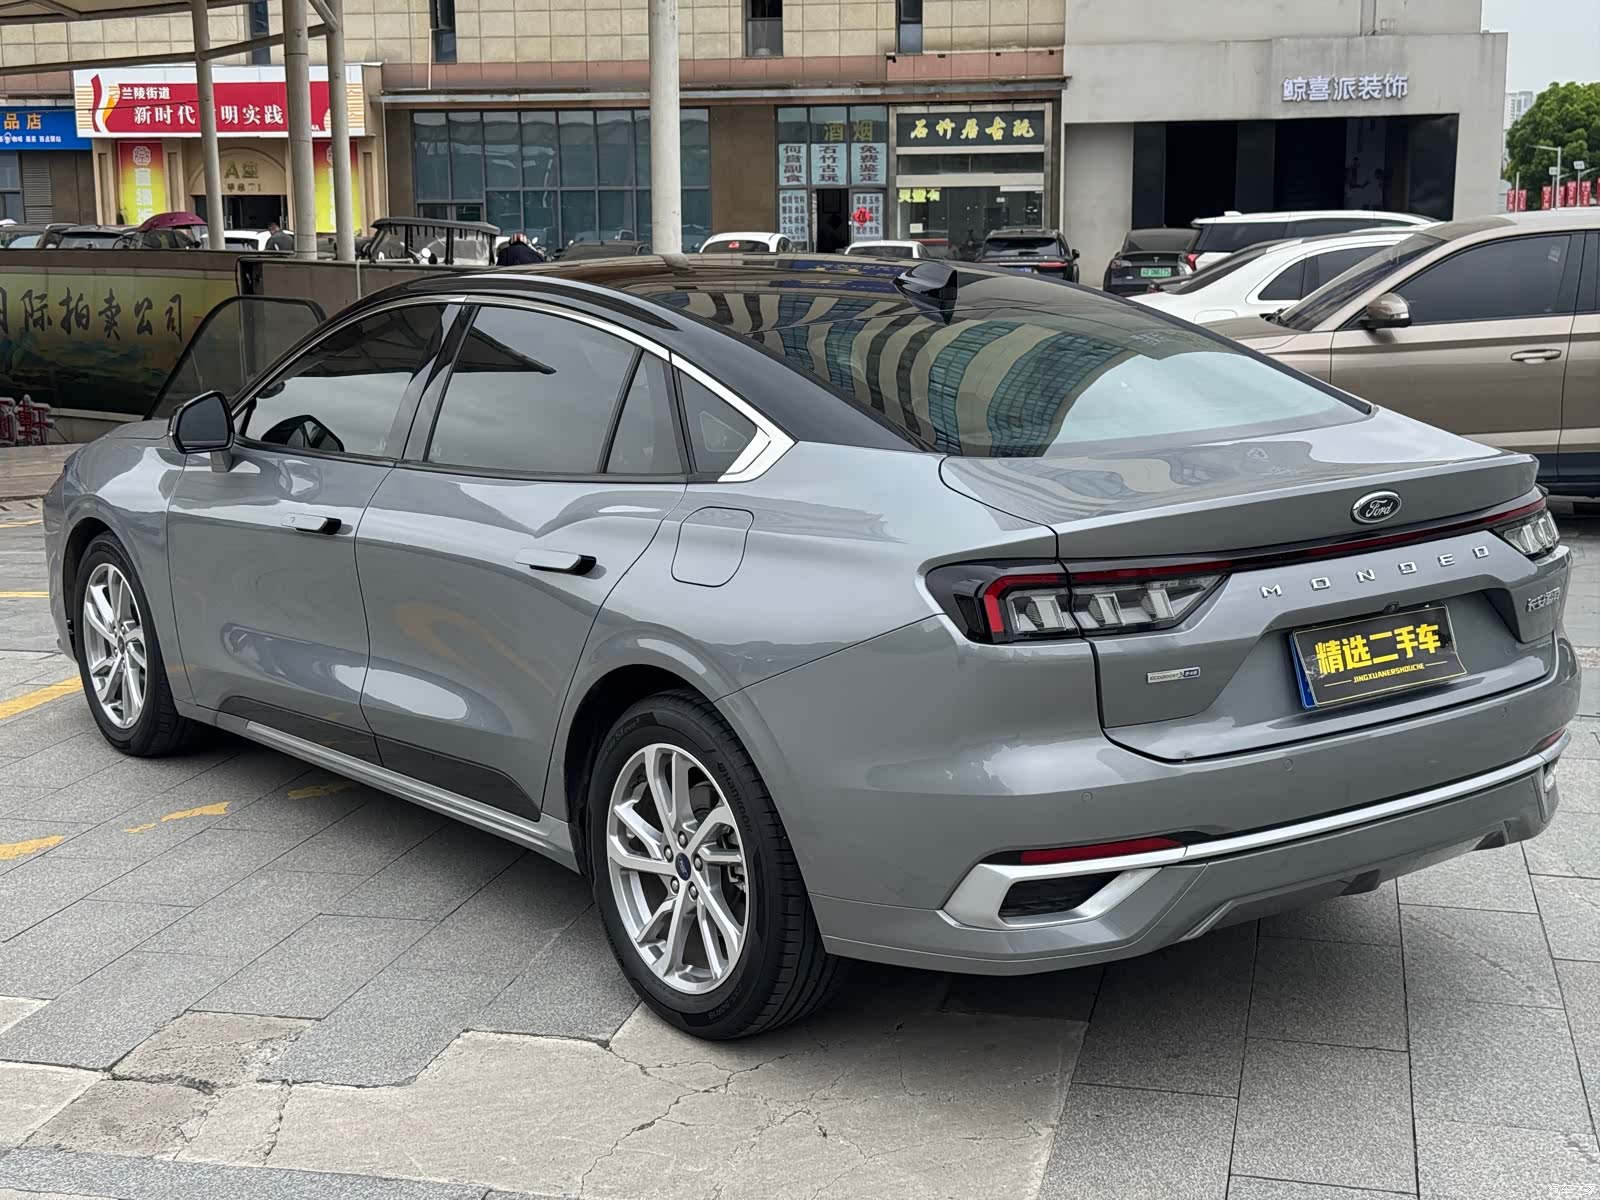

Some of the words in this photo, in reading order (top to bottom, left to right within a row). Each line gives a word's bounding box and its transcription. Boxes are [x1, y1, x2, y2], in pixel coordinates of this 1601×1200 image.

[121, 86, 171, 100] 兰陵街道
[1282, 74, 1408, 102] 鲸喜派装饰
[133, 103, 284, 125] 新时代明实践
[910, 115, 1035, 141] 石竹居古玩
[818, 145, 839, 183] 石竹古玩
[859, 144, 880, 183] 免费鉴定
[1365, 499, 1394, 518] Ford
[1260, 545, 1490, 598] MONDEO
[1314, 623, 1442, 675] 精选二手车
[1353, 662, 1426, 684] JINGXUANERSHOUCHE
